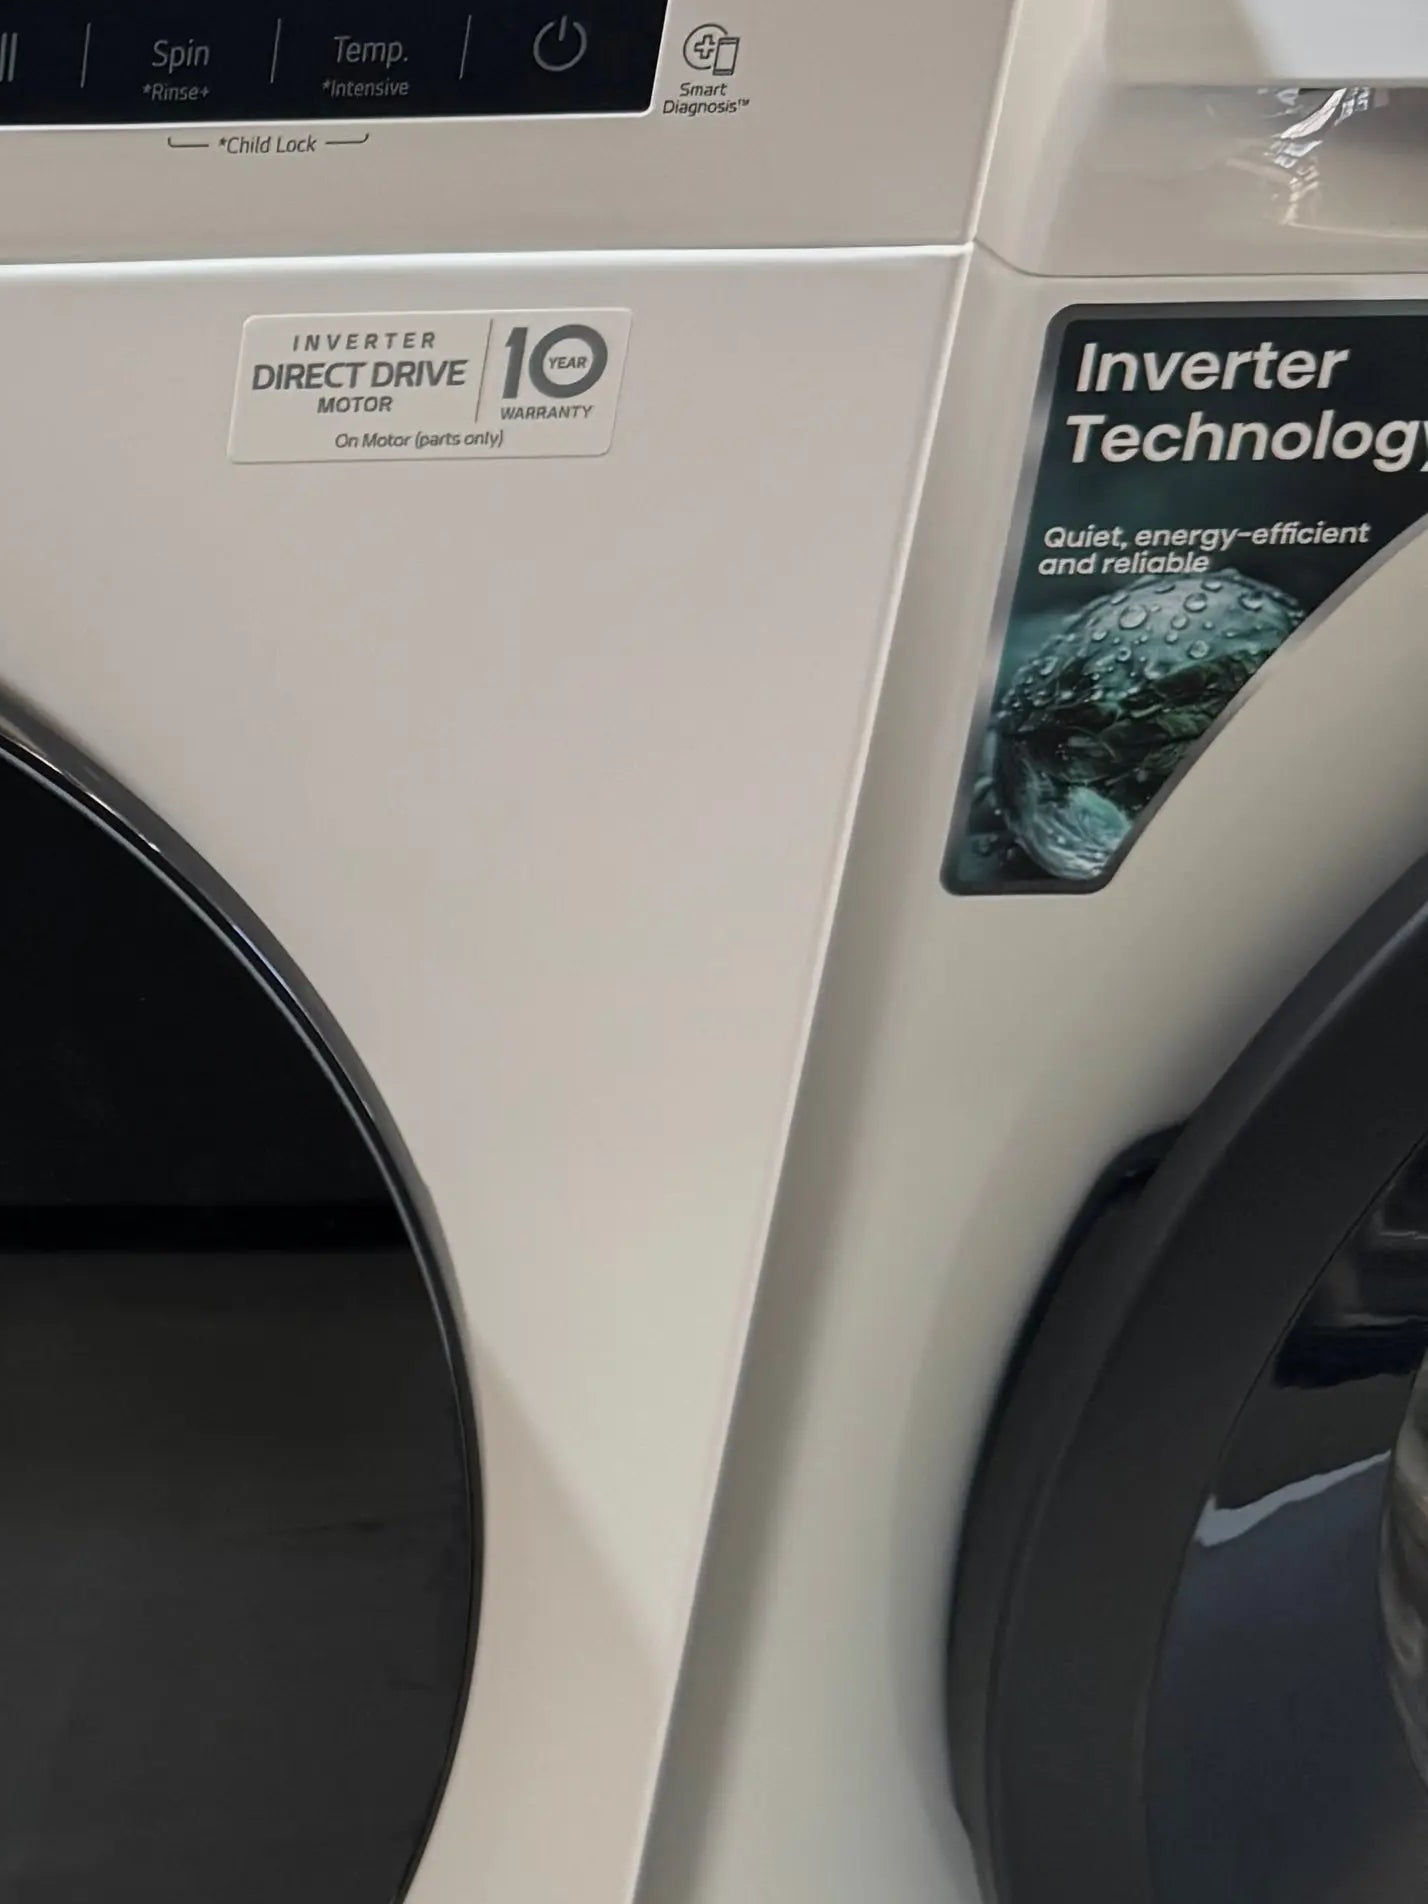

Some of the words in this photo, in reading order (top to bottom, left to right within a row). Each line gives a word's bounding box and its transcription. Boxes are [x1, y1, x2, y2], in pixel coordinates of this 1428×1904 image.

[152, 39, 210, 75] Spin
[334, 35, 409, 70] Temp.
[679, 82, 728, 98] Smart
[277, 135, 318, 154] Lock
[292, 331, 437, 353] INVERTER
[502, 323, 609, 399] 10
[547, 355, 587, 370] YEAR
[1075, 341, 1350, 393] Inverter
[251, 361, 366, 391] DIRECT
[370, 358, 469, 388] DRIVE
[317, 396, 394, 414] MOTOR
[500, 403, 593, 421] WARRANTY
[335, 432, 359, 448] On
[362, 431, 411, 448] Motor
[414, 431, 461, 451] (parts
[464, 429, 504, 450] only)
[1044, 524, 1128, 551] Quiet,
[1134, 521, 1371, 551] energy-efficient
[1038, 553, 1094, 575] and
[1101, 552, 1210, 573] reliable
